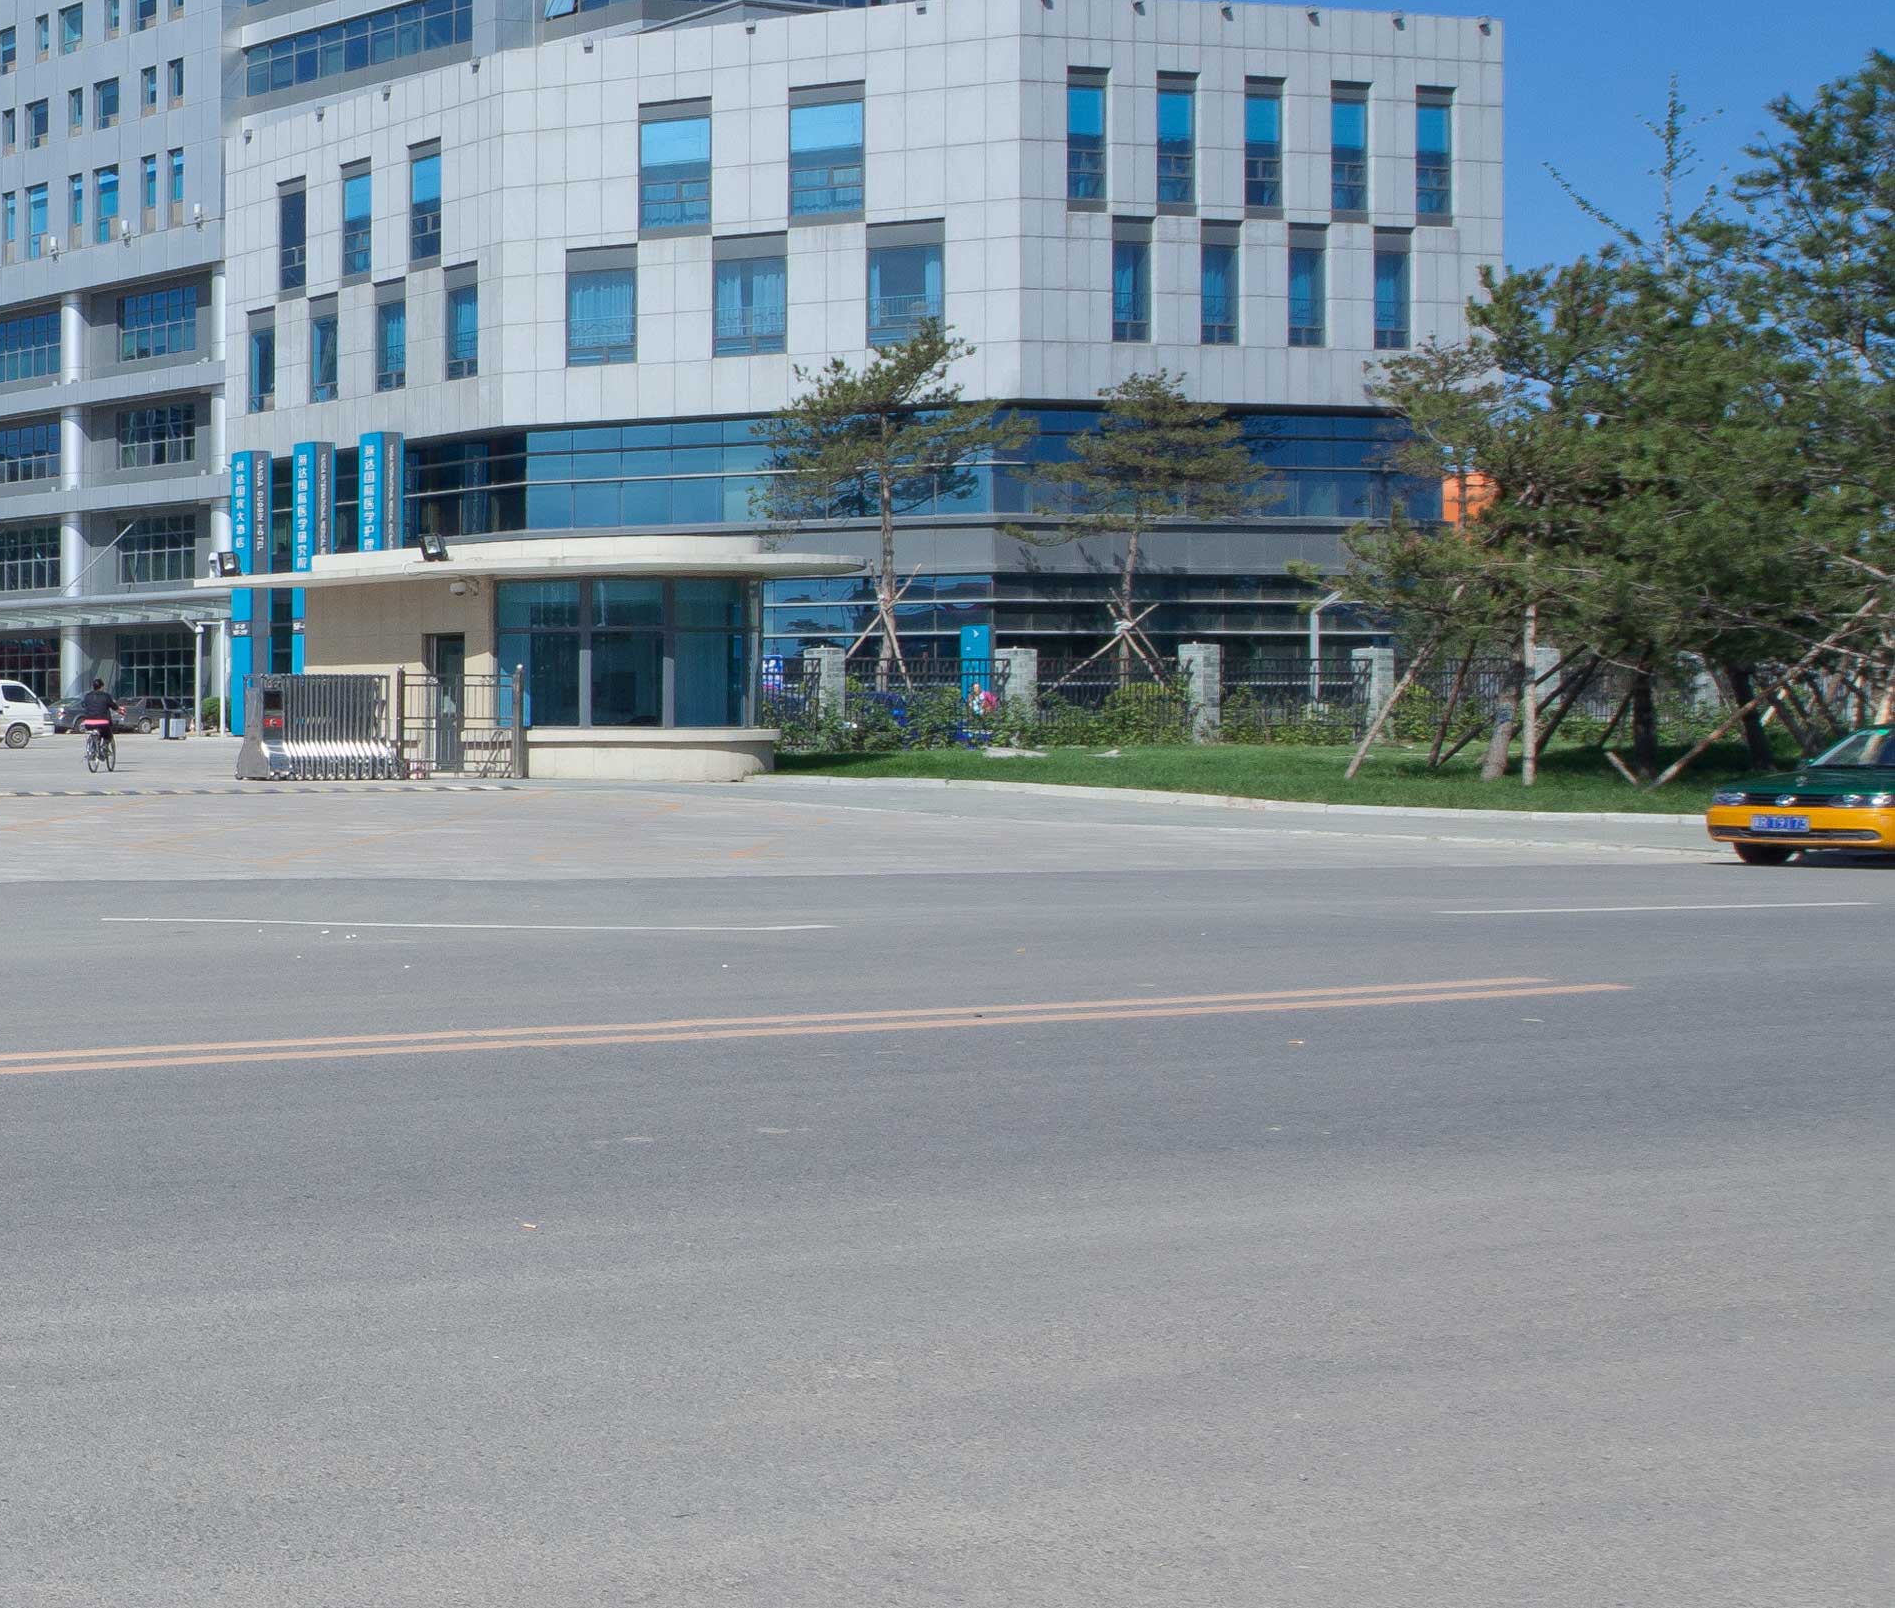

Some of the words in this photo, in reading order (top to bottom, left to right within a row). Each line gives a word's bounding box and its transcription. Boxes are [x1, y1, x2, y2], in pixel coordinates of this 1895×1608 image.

[256, 459, 265, 487] YANDA
[235, 461, 245, 549] 燕达国宾大酒店
[256, 524, 265, 551] HOTEL
